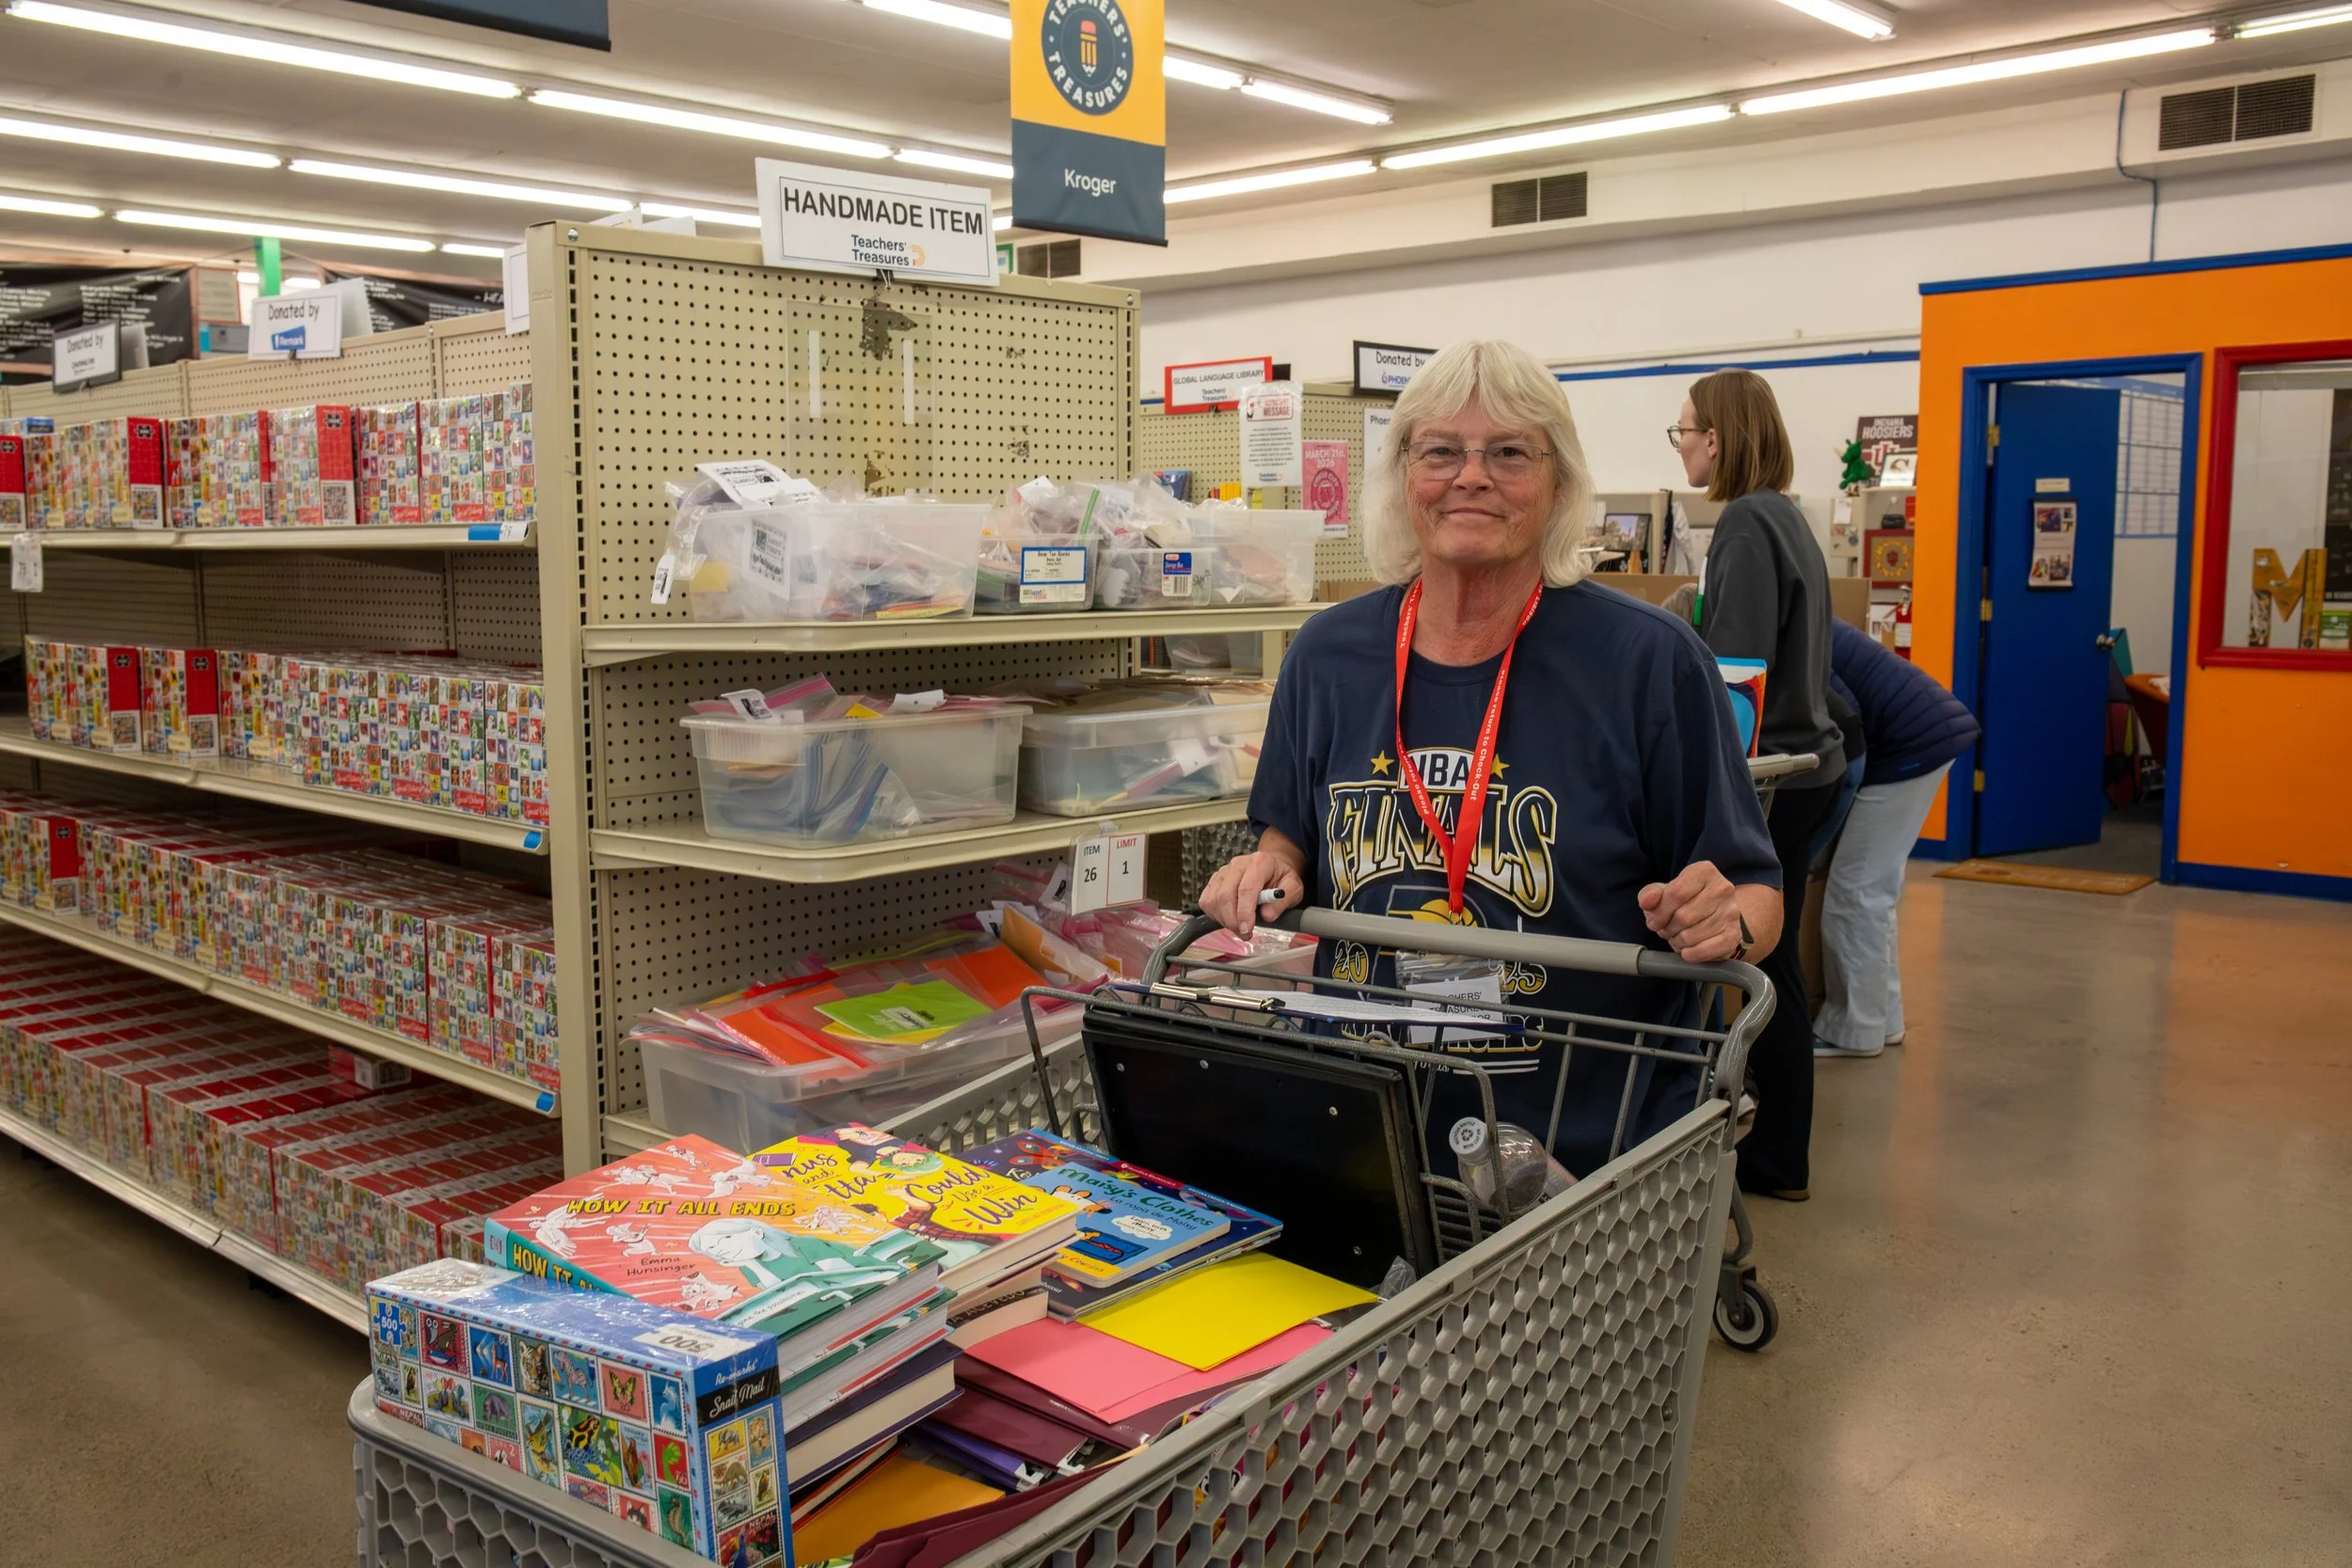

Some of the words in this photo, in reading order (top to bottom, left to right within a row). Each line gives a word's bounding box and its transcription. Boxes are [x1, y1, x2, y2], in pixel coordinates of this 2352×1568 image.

[1049, 0, 1128, 43] TEAERS'
[1048, 51, 1128, 109] TREASURES
[1064, 167, 1117, 197] Kroger
[784, 186, 924, 228] HANDMADE
[929, 206, 984, 235] ITEM
[850, 233, 907, 253] Teachers'
[851, 248, 910, 266] Treasures
[268, 302, 306, 321] Donated
[308, 300, 320, 323] by
[67, 335, 94, 354] Donated
[95, 334, 104, 355] by
[1375, 350, 1411, 367] Donated
[1173, 374, 1198, 385] GLOBAL
[1200, 372, 1235, 383] LANGUAGE
[1235, 370, 1264, 380] LIBRARY
[1263, 406, 1290, 417] MESSAGE
[1873, 417, 1904, 426] INDIANA
[1862, 425, 1914, 439] HOOSIERS
[1305, 449, 1328, 459] MARCH
[1316, 459, 1336, 468] 2026
[1522, 595, 1541, 626] Liaison
[1400, 605, 1413, 648] Teachers'
[1485, 704, 1498, 735] return
[1482, 736, 1489, 748] to
[1405, 752, 1471, 788] NBA
[1470, 748, 1488, 801] Check-Out
[1414, 786, 1430, 816] Please
[1083, 844, 1101, 857] ITEM
[1116, 837, 1137, 849] LIMIT
[1327, 780, 1558, 918] FINALS
[1083, 866, 1097, 883] 26
[1121, 861, 1129, 875] 1
[1332, 939, 1369, 985] 20
[782, 1151, 838, 1180] nus
[802, 1167, 835, 1184] and
[823, 1174, 877, 1199] tta
[905, 1165, 991, 1206] Could
[951, 1188, 982, 1202] Use
[1057, 1166, 1137, 1200] Maisy's
[1139, 1196, 1215, 1227] Clothes
[566, 1199, 629, 1215] HOW
[639, 1200, 671, 1215] IT
[677, 1201, 723, 1216] ALL
[729, 1201, 797, 1217] ENDS
[962, 1194, 1038, 1225] Win
[1110, 1196, 1123, 1204] La
[1124, 1201, 1149, 1214] ropa
[1151, 1210, 1165, 1219] de
[512, 1243, 548, 1279] HOW
[551, 1262, 574, 1284] IT
[626, 1262, 697, 1277] Hunsinger
[640, 1257, 682, 1266] Emma
[1069, 1256, 1105, 1273] Cousins
[965, 1290, 1026, 1316] ACEVEDO
[381, 1319, 398, 1331] 500
[715, 1359, 755, 1386] Re-marks
[709, 1393, 739, 1418] Snail
[739, 1376, 766, 1404] Mail
[509, 1444, 516, 1457] 2
[749, 1512, 775, 1528] NEPAL
